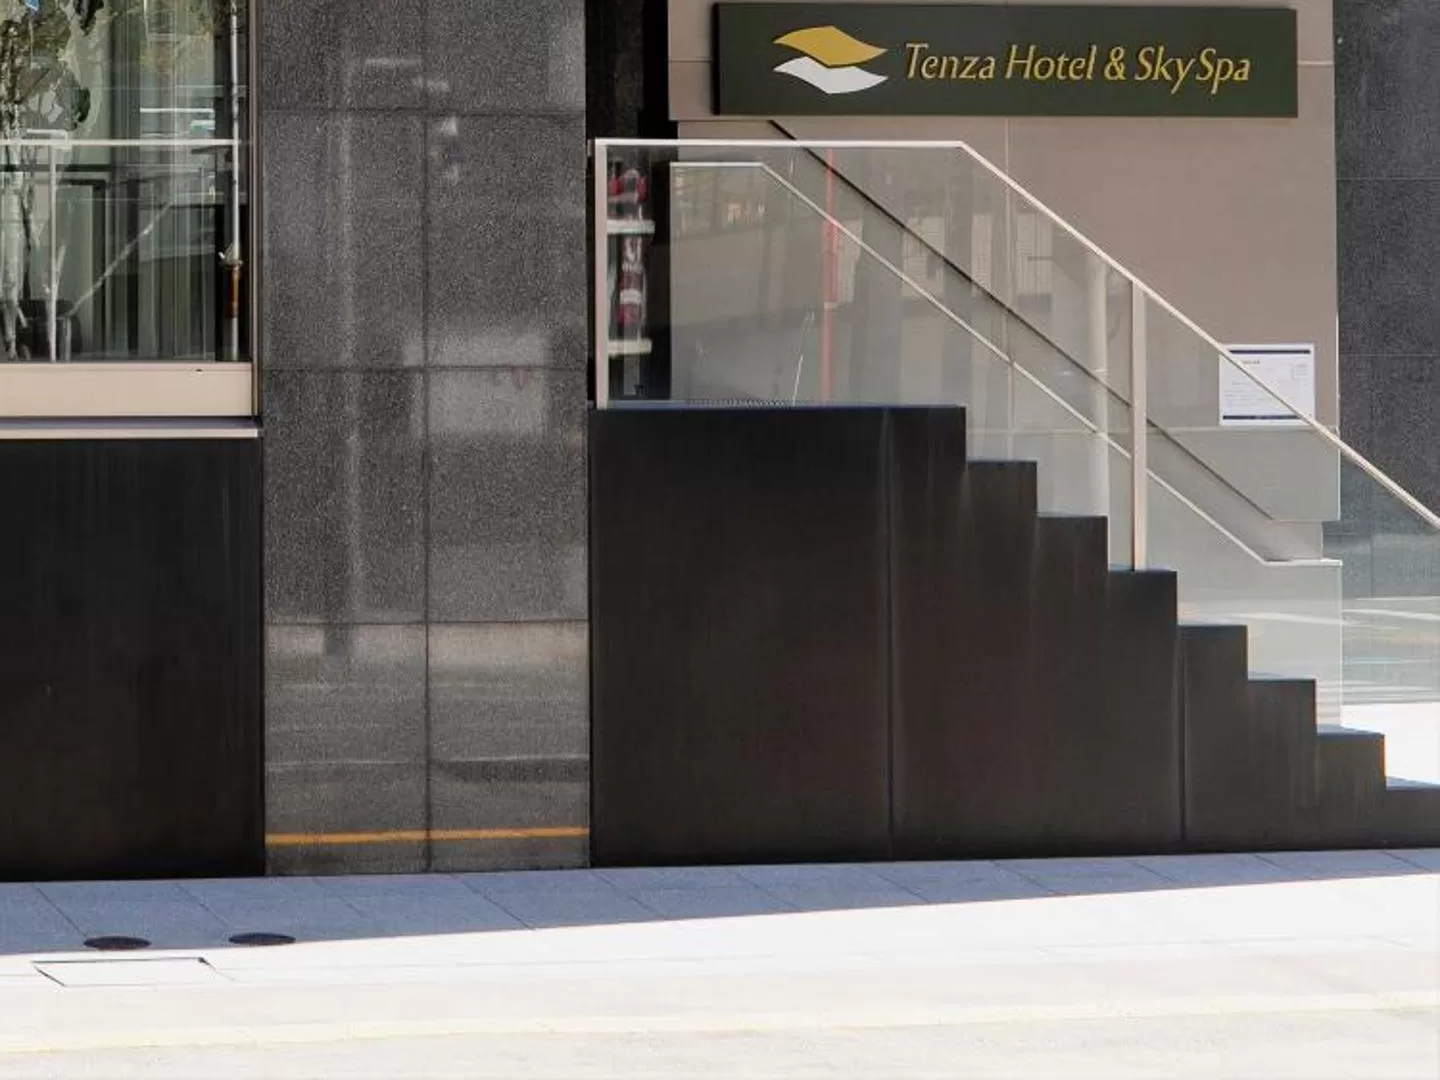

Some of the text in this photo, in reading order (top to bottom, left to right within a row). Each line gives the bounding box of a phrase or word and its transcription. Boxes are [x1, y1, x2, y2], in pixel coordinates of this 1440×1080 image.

[905, 42, 996, 81] Tenza
[1004, 44, 1098, 81] Hotel
[1103, 46, 1127, 81] &
